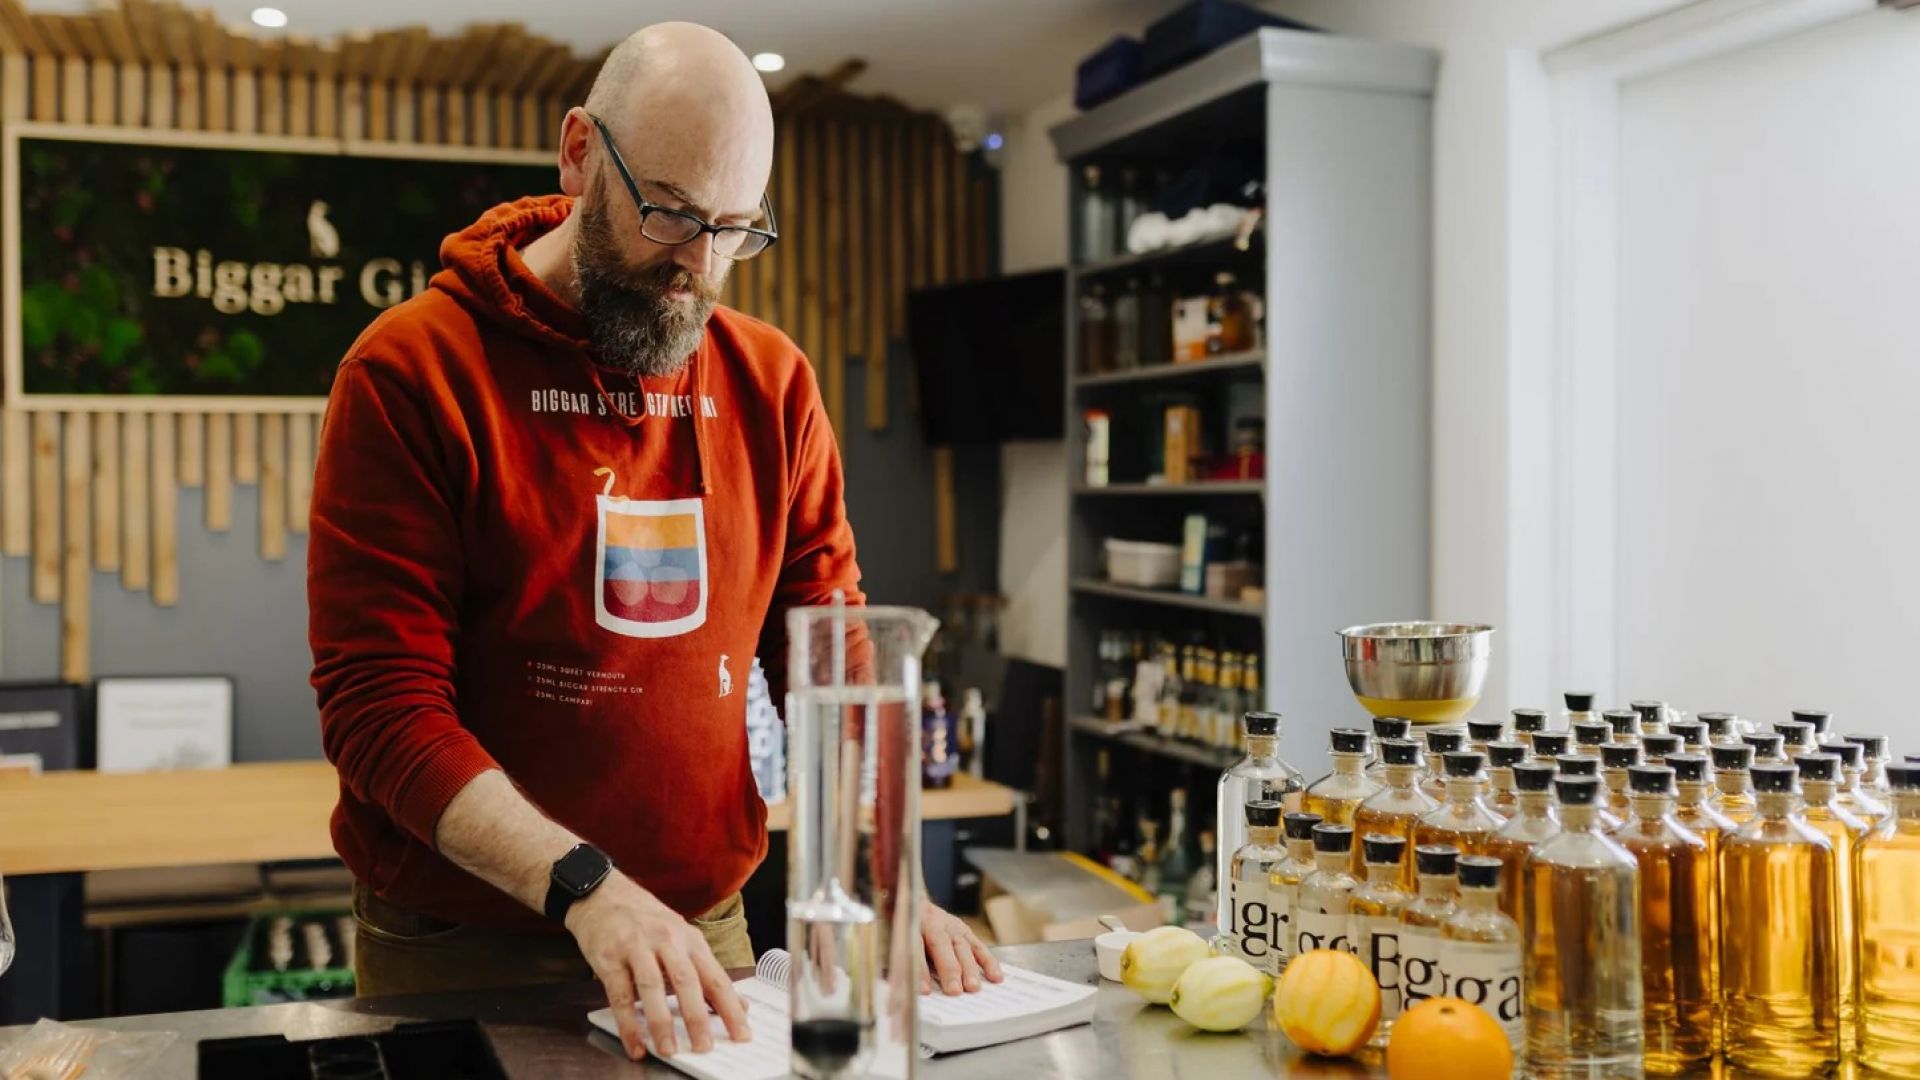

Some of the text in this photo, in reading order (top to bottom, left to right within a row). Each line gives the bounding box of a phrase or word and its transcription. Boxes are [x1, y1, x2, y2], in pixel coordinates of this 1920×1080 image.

[153, 245, 427, 316] Biggar Gi
[531, 388, 590, 416] BIGGAR
